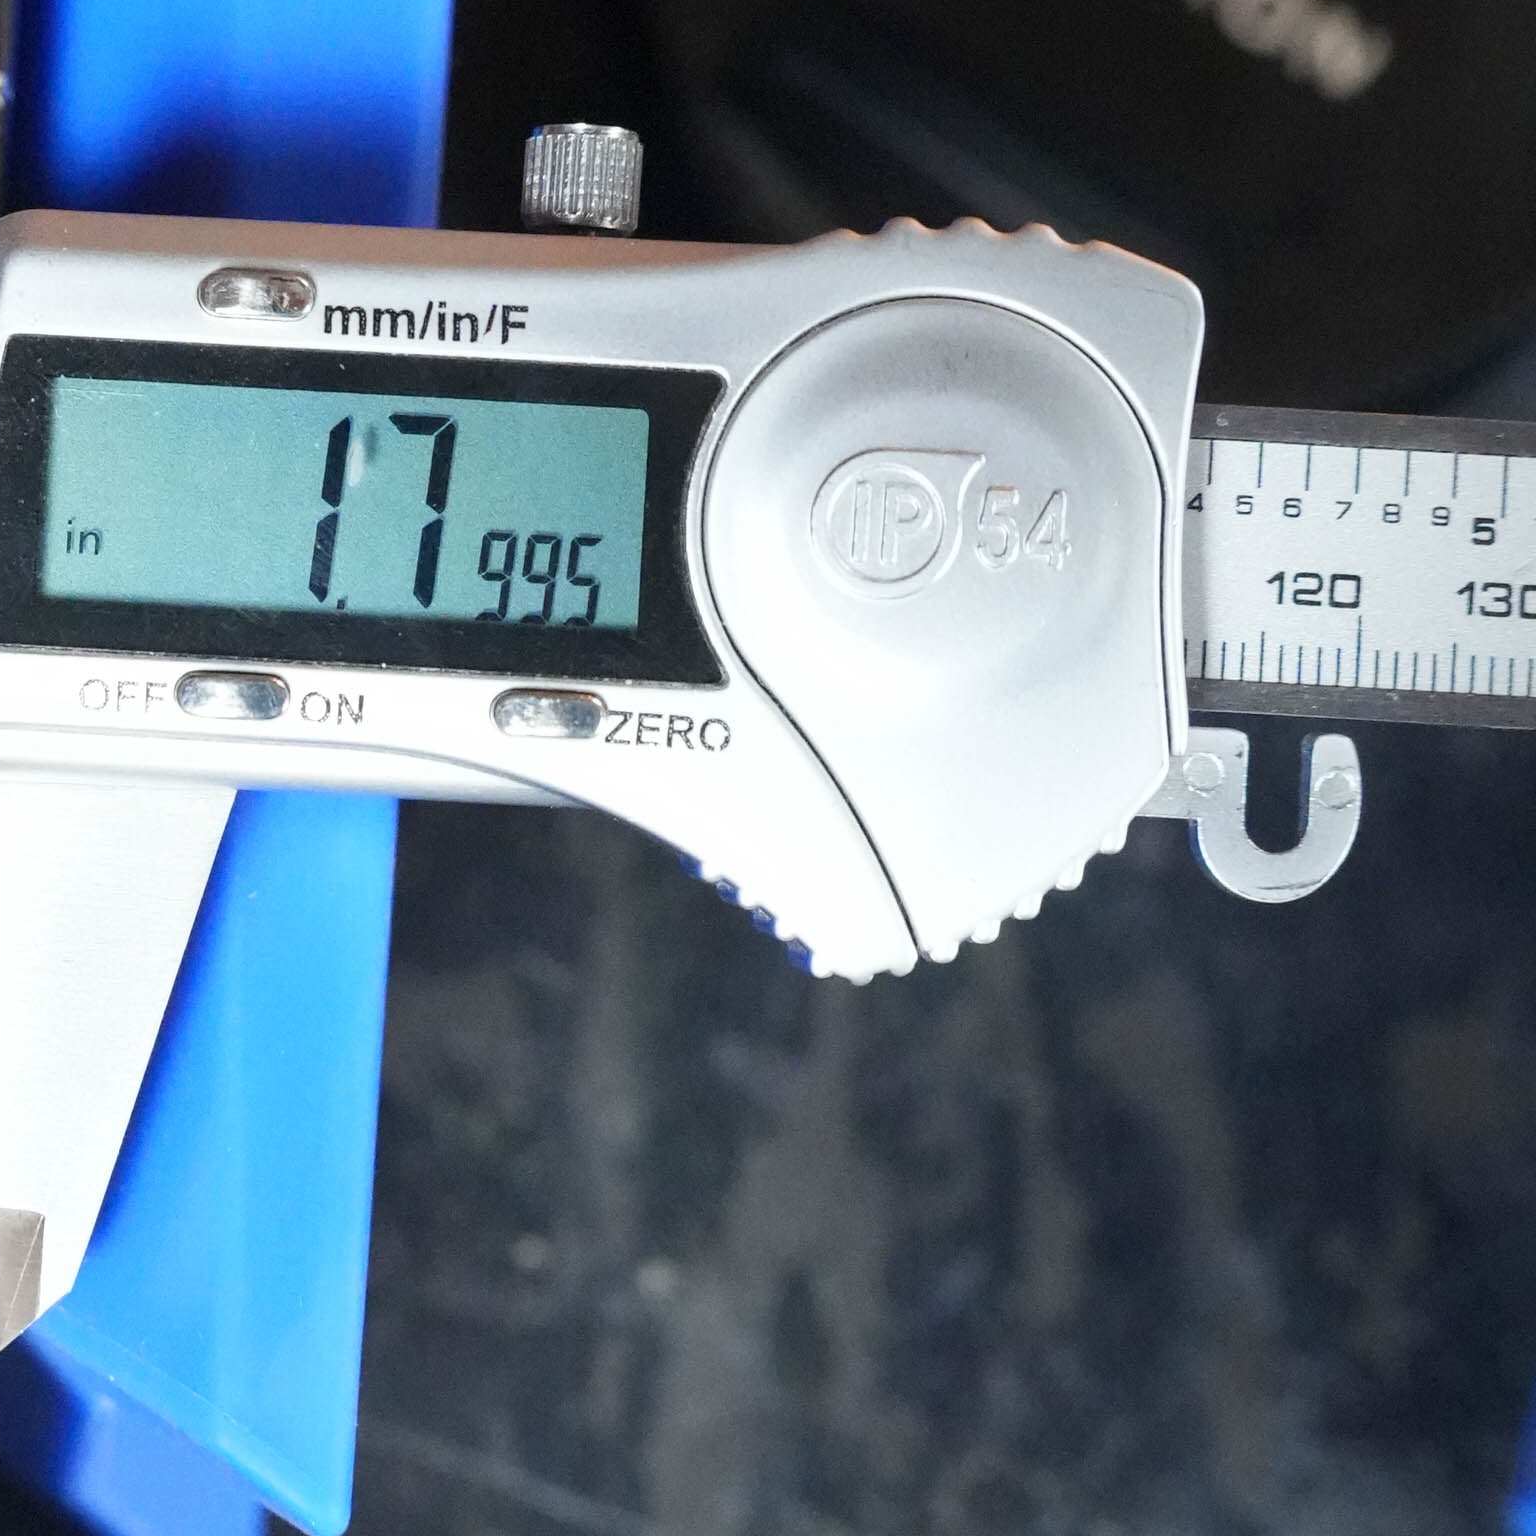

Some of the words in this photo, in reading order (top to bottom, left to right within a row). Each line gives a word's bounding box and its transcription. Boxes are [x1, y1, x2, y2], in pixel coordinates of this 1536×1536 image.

[323, 300, 529, 345] mm/in/F
[66, 517, 103, 557] in
[850, 479, 933, 566] IP
[975, 485, 1073, 571] 54
[1187, 492, 1204, 513] 4
[1235, 495, 1254, 515] 5
[1282, 498, 1302, 518] 6
[1335, 501, 1353, 520] 7
[1382, 503, 1401, 524] 8
[1431, 506, 1451, 527] 9
[1471, 517, 1496, 546] 5
[1266, 571, 1361, 609] 120
[78, 678, 168, 712] OFF
[300, 691, 365, 726] ON
[604, 710, 732, 753] ZERO
